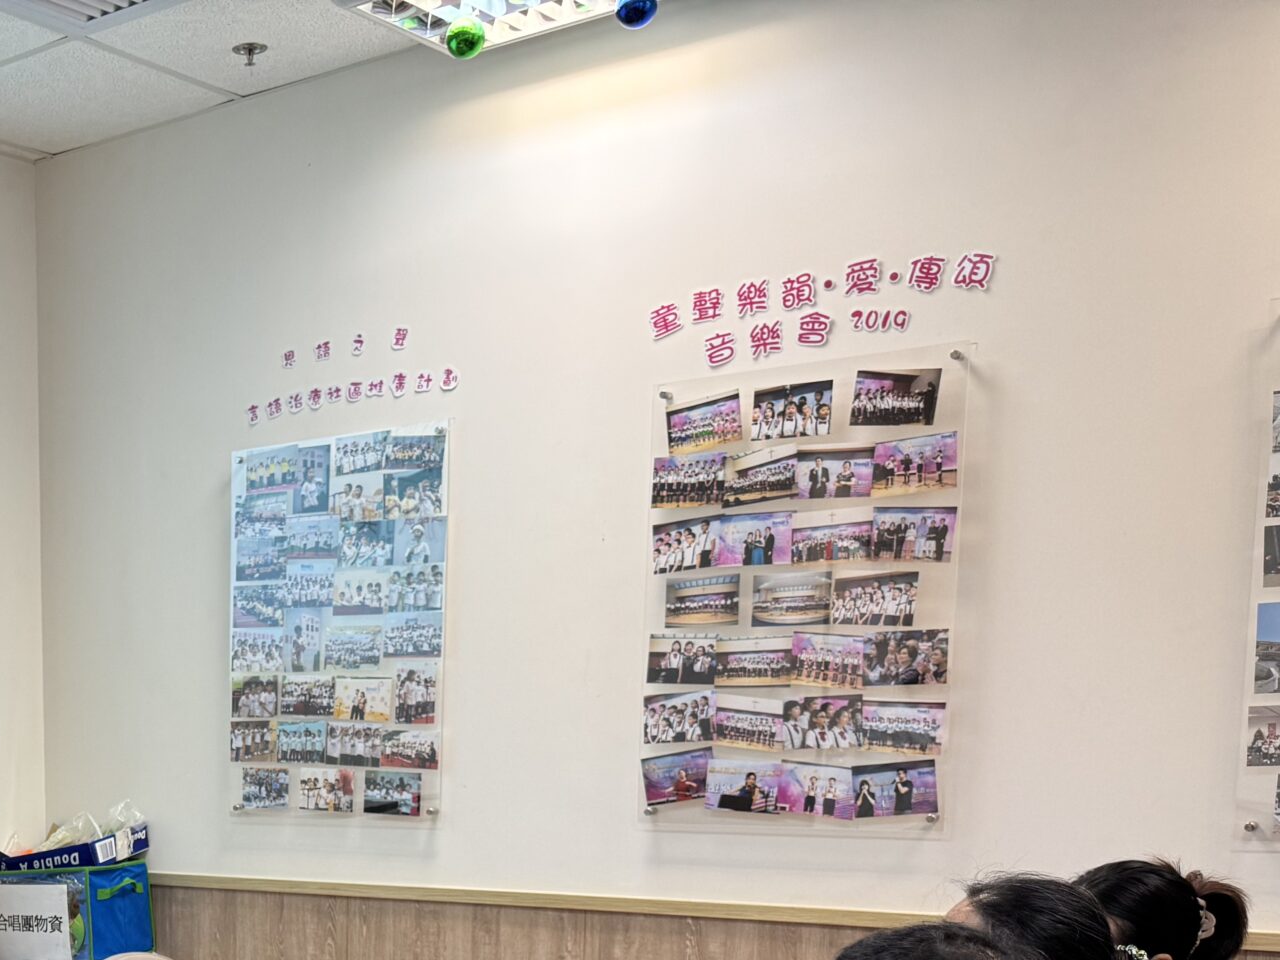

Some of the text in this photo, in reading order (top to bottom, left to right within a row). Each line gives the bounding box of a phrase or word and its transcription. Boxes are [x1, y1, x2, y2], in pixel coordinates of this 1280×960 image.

[705, 310, 908, 365] 音樂會 2019
[248, 368, 457, 422] 言語治療社區推廣計劃
[19, 862, 28, 871] A
[33, 852, 80, 870] Double
